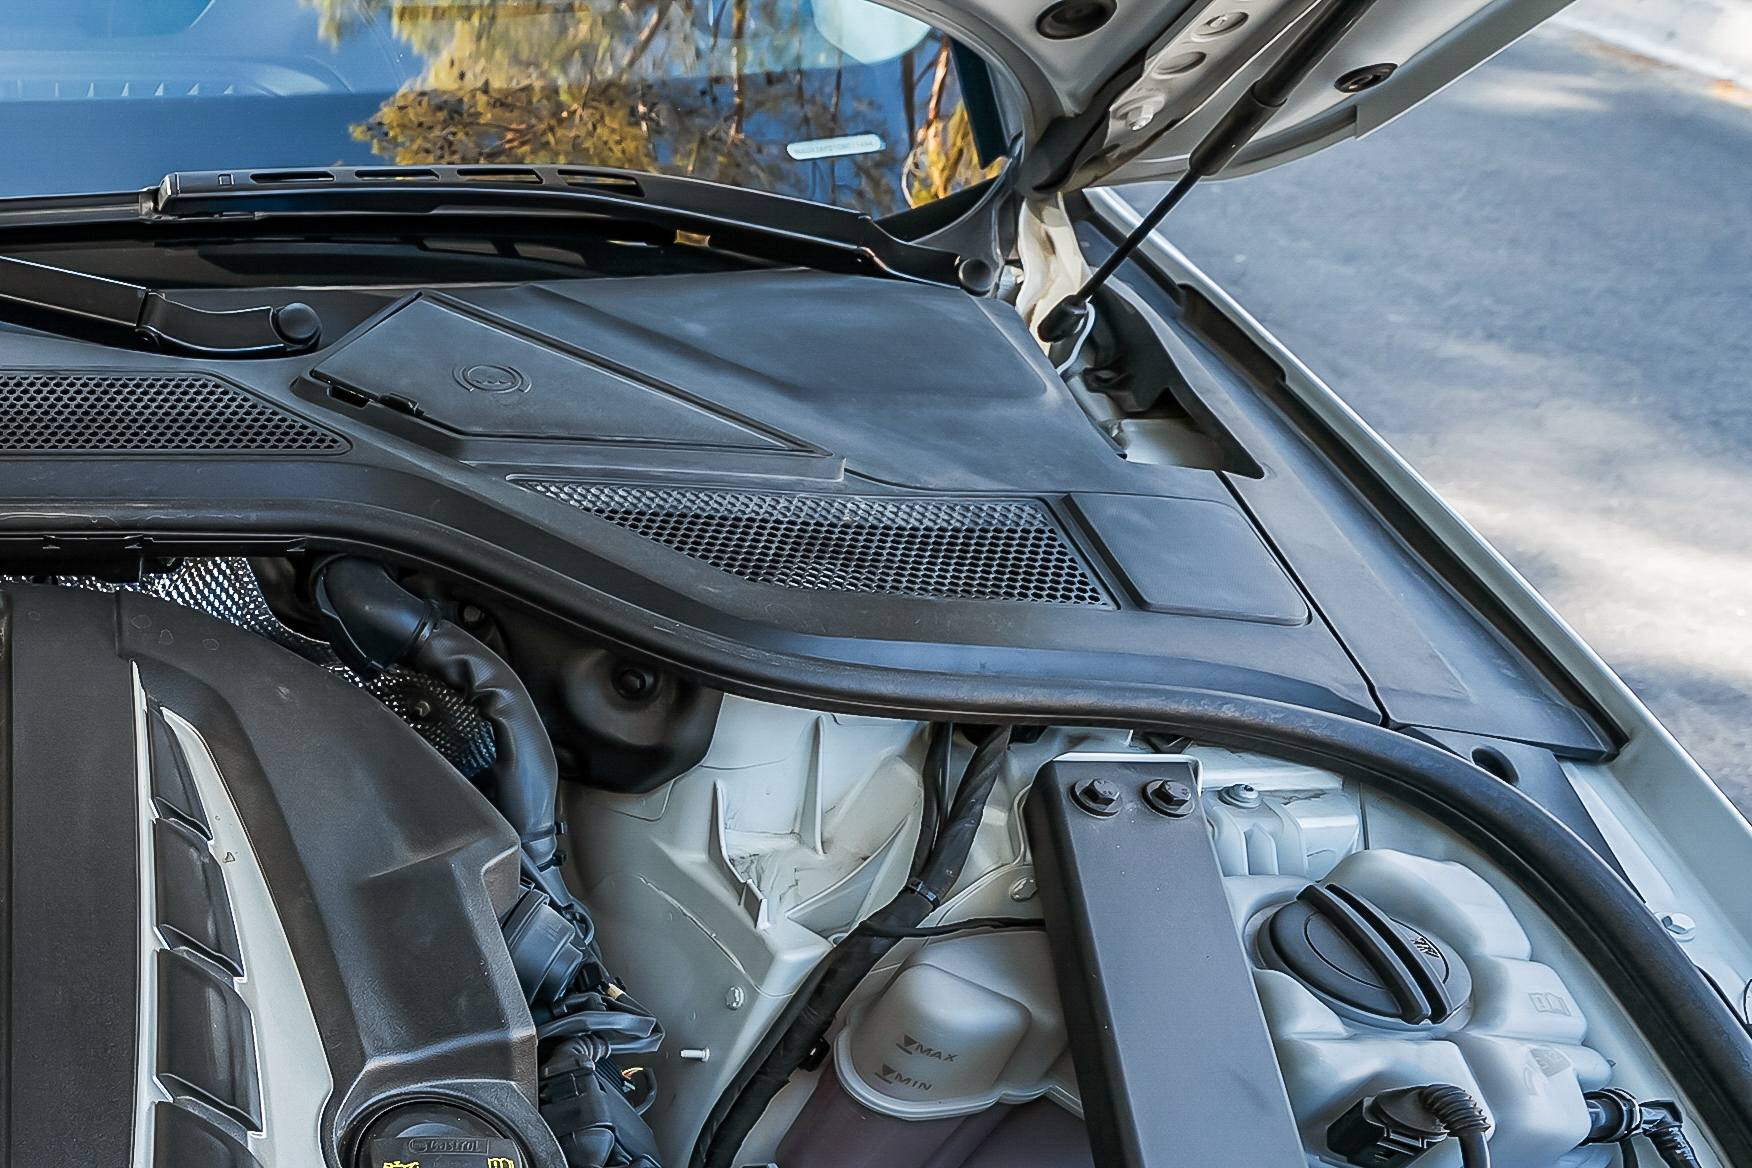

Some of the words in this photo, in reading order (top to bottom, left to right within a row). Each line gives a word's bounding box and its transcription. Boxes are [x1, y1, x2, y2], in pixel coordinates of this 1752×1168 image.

[915, 1044, 958, 1061] MAX
[895, 1074, 933, 1090] MIN
[429, 1139, 480, 1152] Castrol
